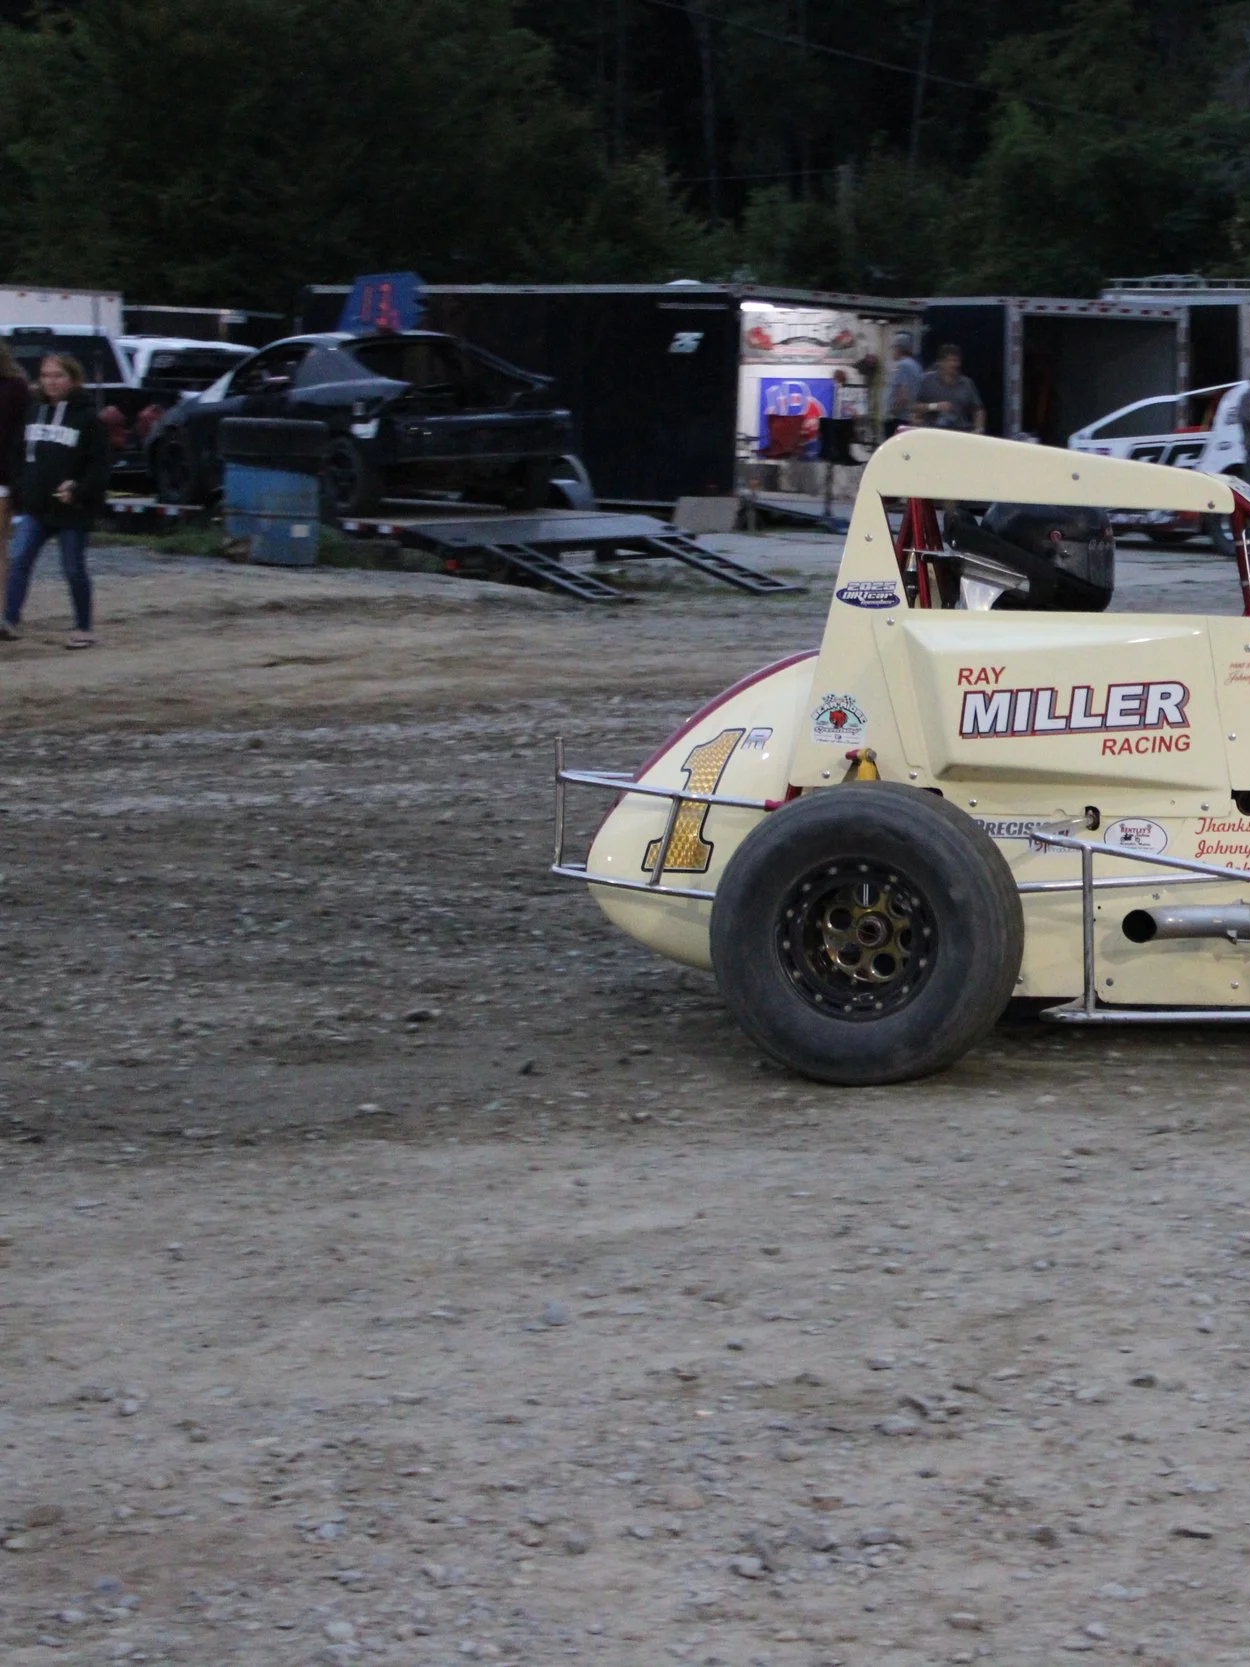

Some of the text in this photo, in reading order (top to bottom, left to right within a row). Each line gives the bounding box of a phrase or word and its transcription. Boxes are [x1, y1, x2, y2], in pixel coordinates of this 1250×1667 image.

[847, 582, 896, 592] 2025
[957, 667, 1006, 686] RAY
[959, 681, 1190, 739] MILLER
[1101, 735, 1191, 756] RACING
[641, 728, 747, 874] 1
